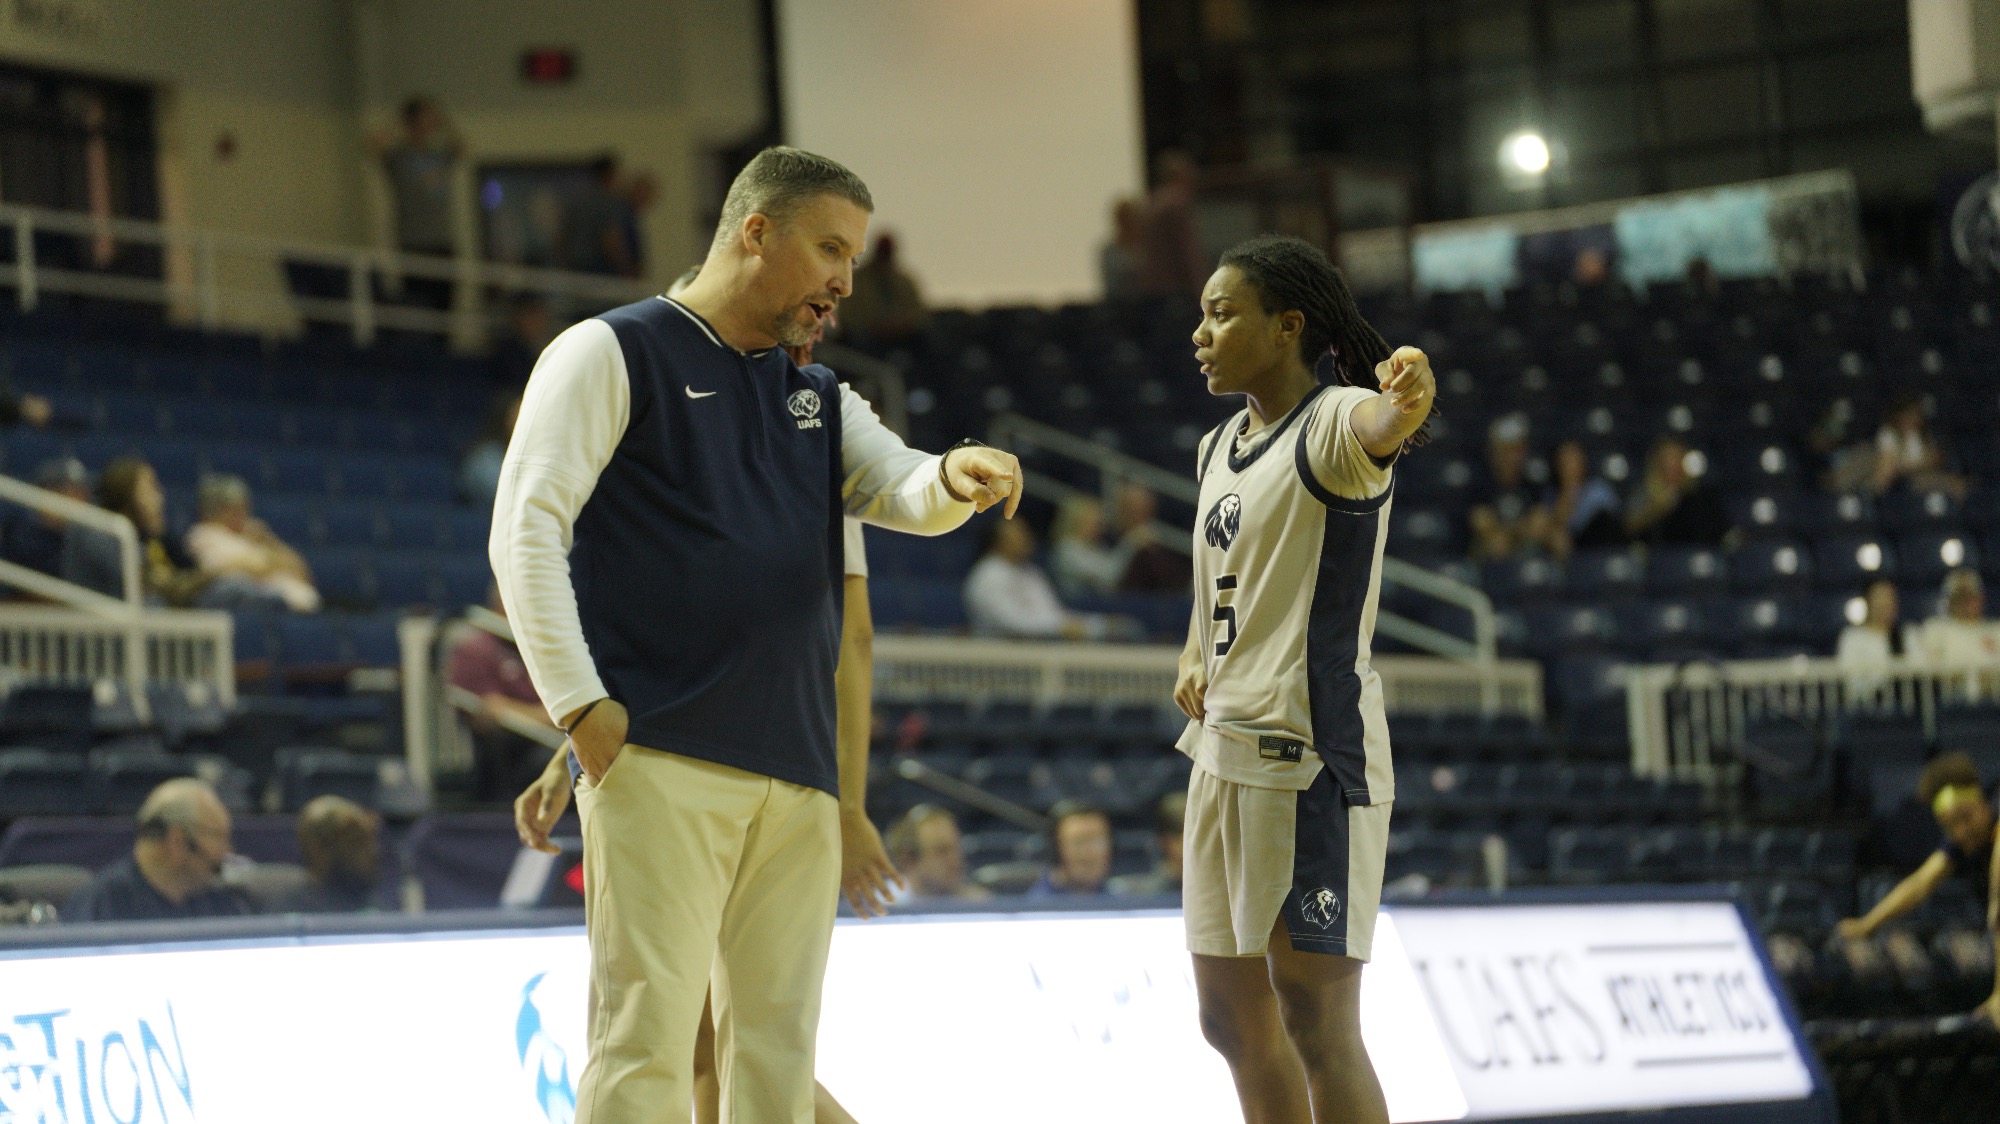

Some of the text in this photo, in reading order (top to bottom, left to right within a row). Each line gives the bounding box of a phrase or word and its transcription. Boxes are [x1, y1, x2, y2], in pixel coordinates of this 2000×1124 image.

[798, 419, 822, 429] UAFS
[1213, 574, 1238, 656] 5
[1287, 745, 1297, 755] M
[1415, 953, 1771, 1071] UAFS ATHLETICS
